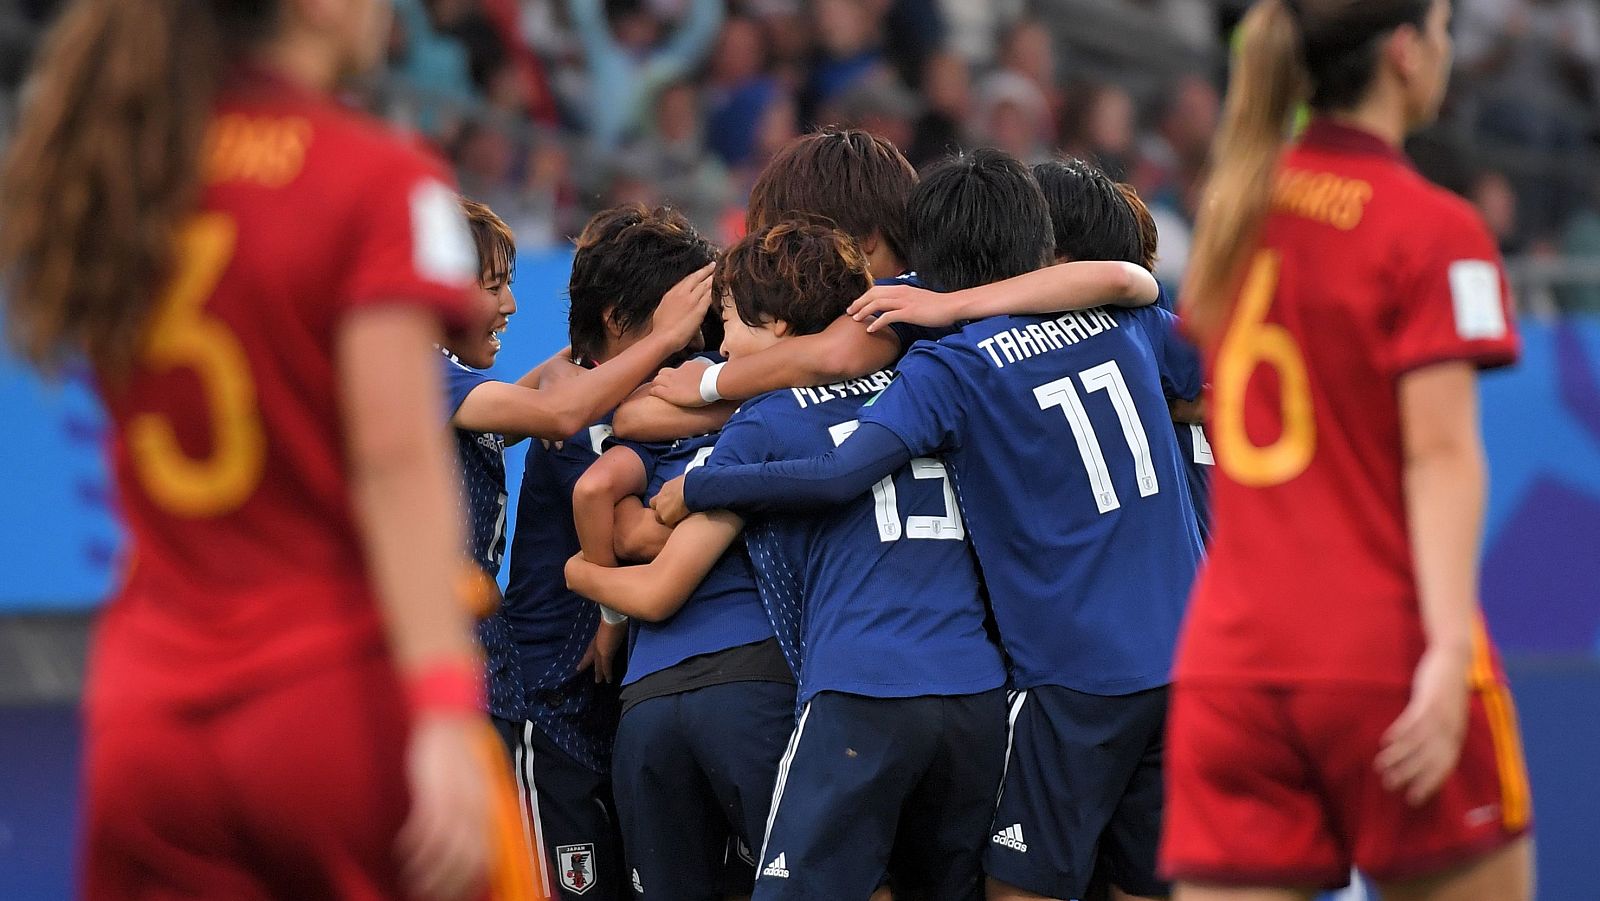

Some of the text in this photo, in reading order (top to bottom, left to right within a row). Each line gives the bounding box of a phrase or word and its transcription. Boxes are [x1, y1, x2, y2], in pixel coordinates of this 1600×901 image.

[124, 209, 268, 518] 3
[977, 307, 1119, 368] TAKARADA
[1211, 248, 1318, 487] 6
[1032, 360, 1159, 514] 11
[763, 867, 790, 878] adidas
[992, 833, 1027, 853] adidas
